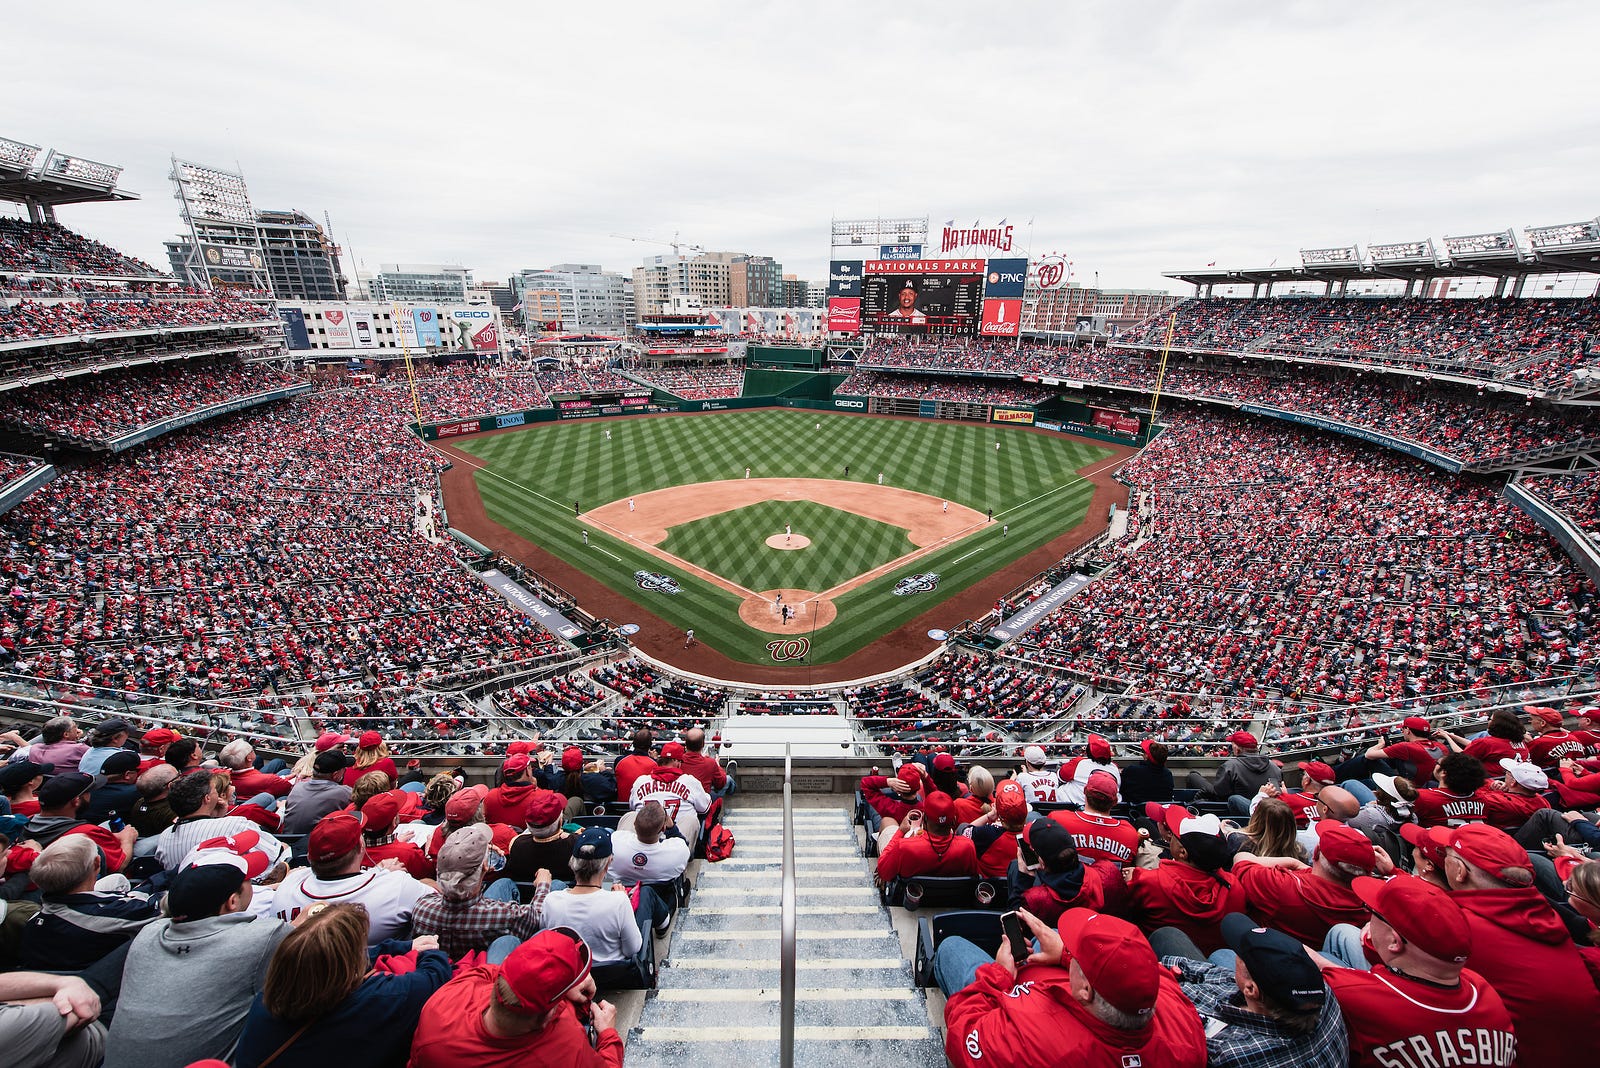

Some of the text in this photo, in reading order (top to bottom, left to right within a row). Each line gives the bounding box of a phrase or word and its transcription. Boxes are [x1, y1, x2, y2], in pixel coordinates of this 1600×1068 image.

[942, 226, 1013, 252] NATIONALS
[944, 262, 977, 270] PARK
[1000, 273, 1024, 282] PNC
[420, 311, 431, 322] W
[835, 400, 863, 408] GEICO
[503, 416, 524, 424] INOVA
[1317, 420, 1329, 428] Health
[1344, 428, 1364, 437] Coverage
[1365, 433, 1378, 441] Partner
[1392, 440, 1411, 452] Nationals
[501, 583, 551, 617] NATIONALS PARK
[1007, 581, 1078, 629] WASHINGTON NATIONALS
[765, 637, 810, 661] W
[637, 781, 690, 800] STRASBURG
[1031, 779, 1055, 788] HARPER
[1034, 790, 1056, 802] 34
[1442, 801, 1485, 816] MURPHY
[1071, 834, 1131, 860] TRASBURG
